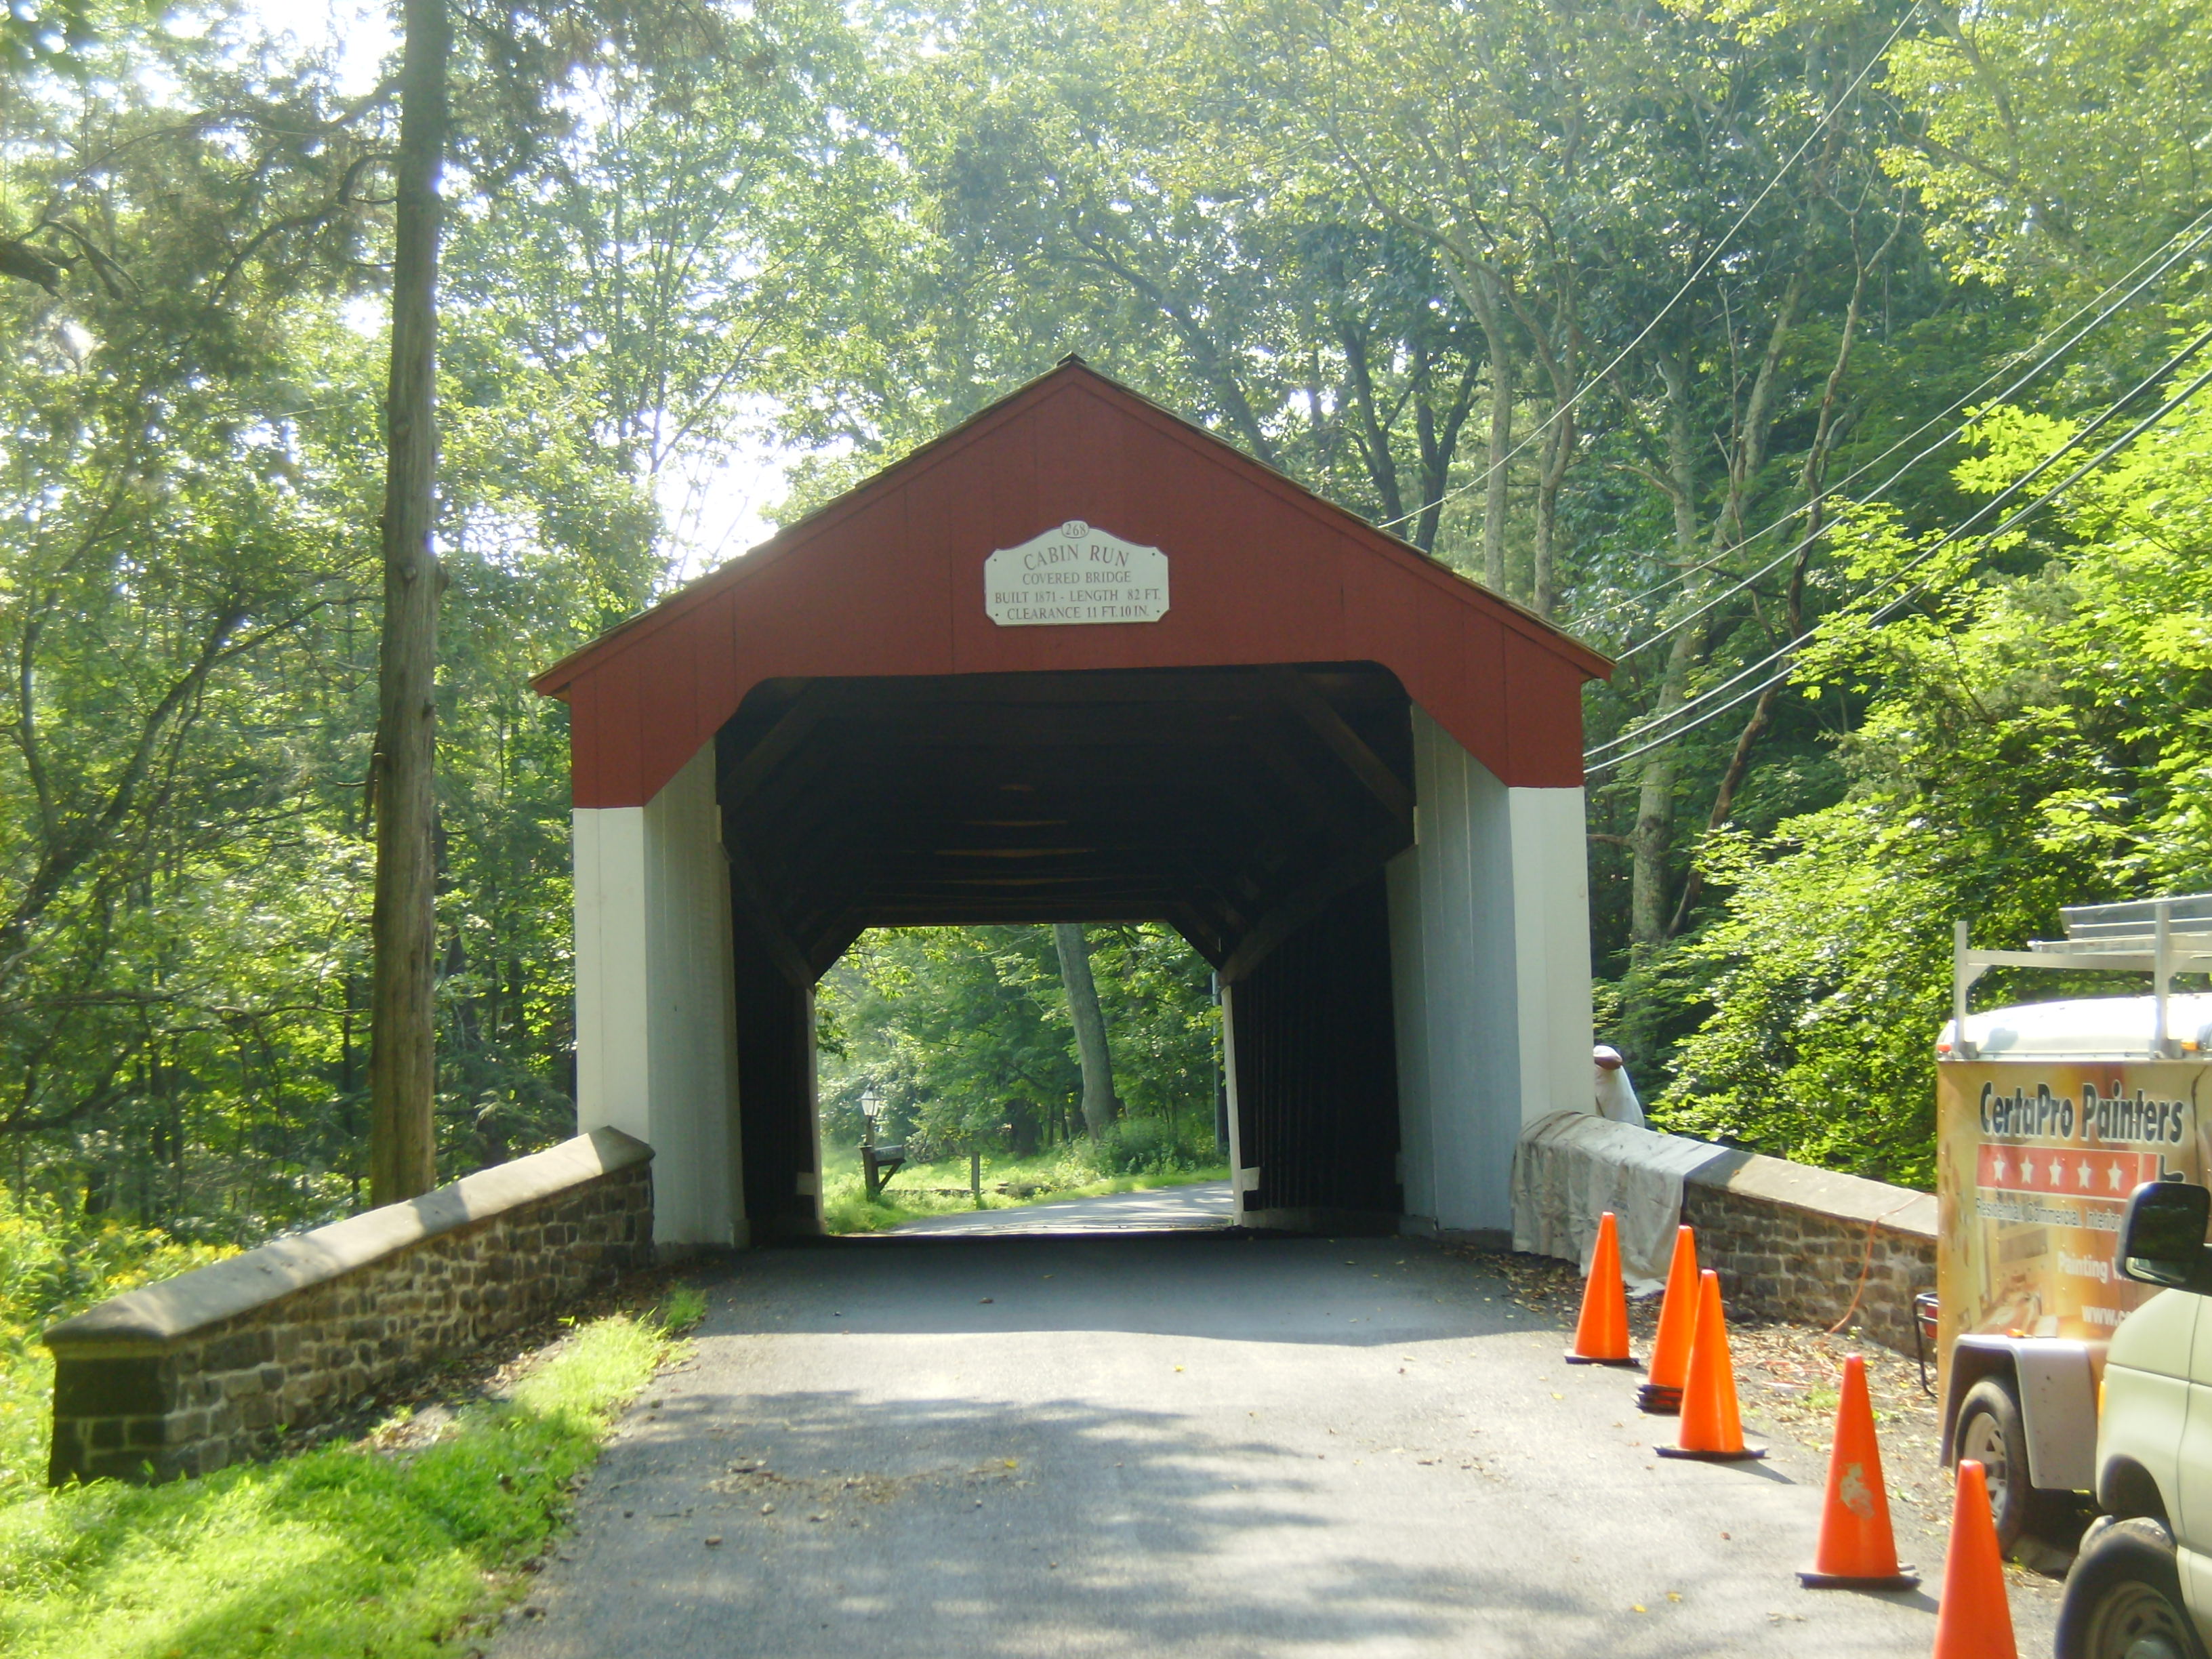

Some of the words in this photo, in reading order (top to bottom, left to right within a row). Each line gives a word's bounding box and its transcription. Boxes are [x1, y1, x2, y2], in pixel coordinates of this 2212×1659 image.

[1065, 523, 1086, 537] 268
[1024, 544, 1079, 571] CABIN
[1090, 545, 1130, 568] RUN
[1023, 573, 1080, 585] COVERED
[1086, 571, 1132, 583] BRIDGE
[995, 591, 1029, 604] BUILT
[1035, 591, 1056, 602] 1871
[1070, 590, 1118, 602] LENGTH
[1127, 589, 1140, 600] 82
[1145, 588, 1161, 600] FT.
[1007, 607, 1081, 620] CLEARANCE
[1087, 607, 1097, 618] 11
[1101, 606, 1118, 617] FT.
[1120, 606, 1131, 617] 10
[1134, 605, 1149, 617] IN.
[1980, 1080, 2074, 1139] CertaPro
[2080, 1079, 2184, 1146] Painters
[2057, 1250, 2108, 1284] Painting
